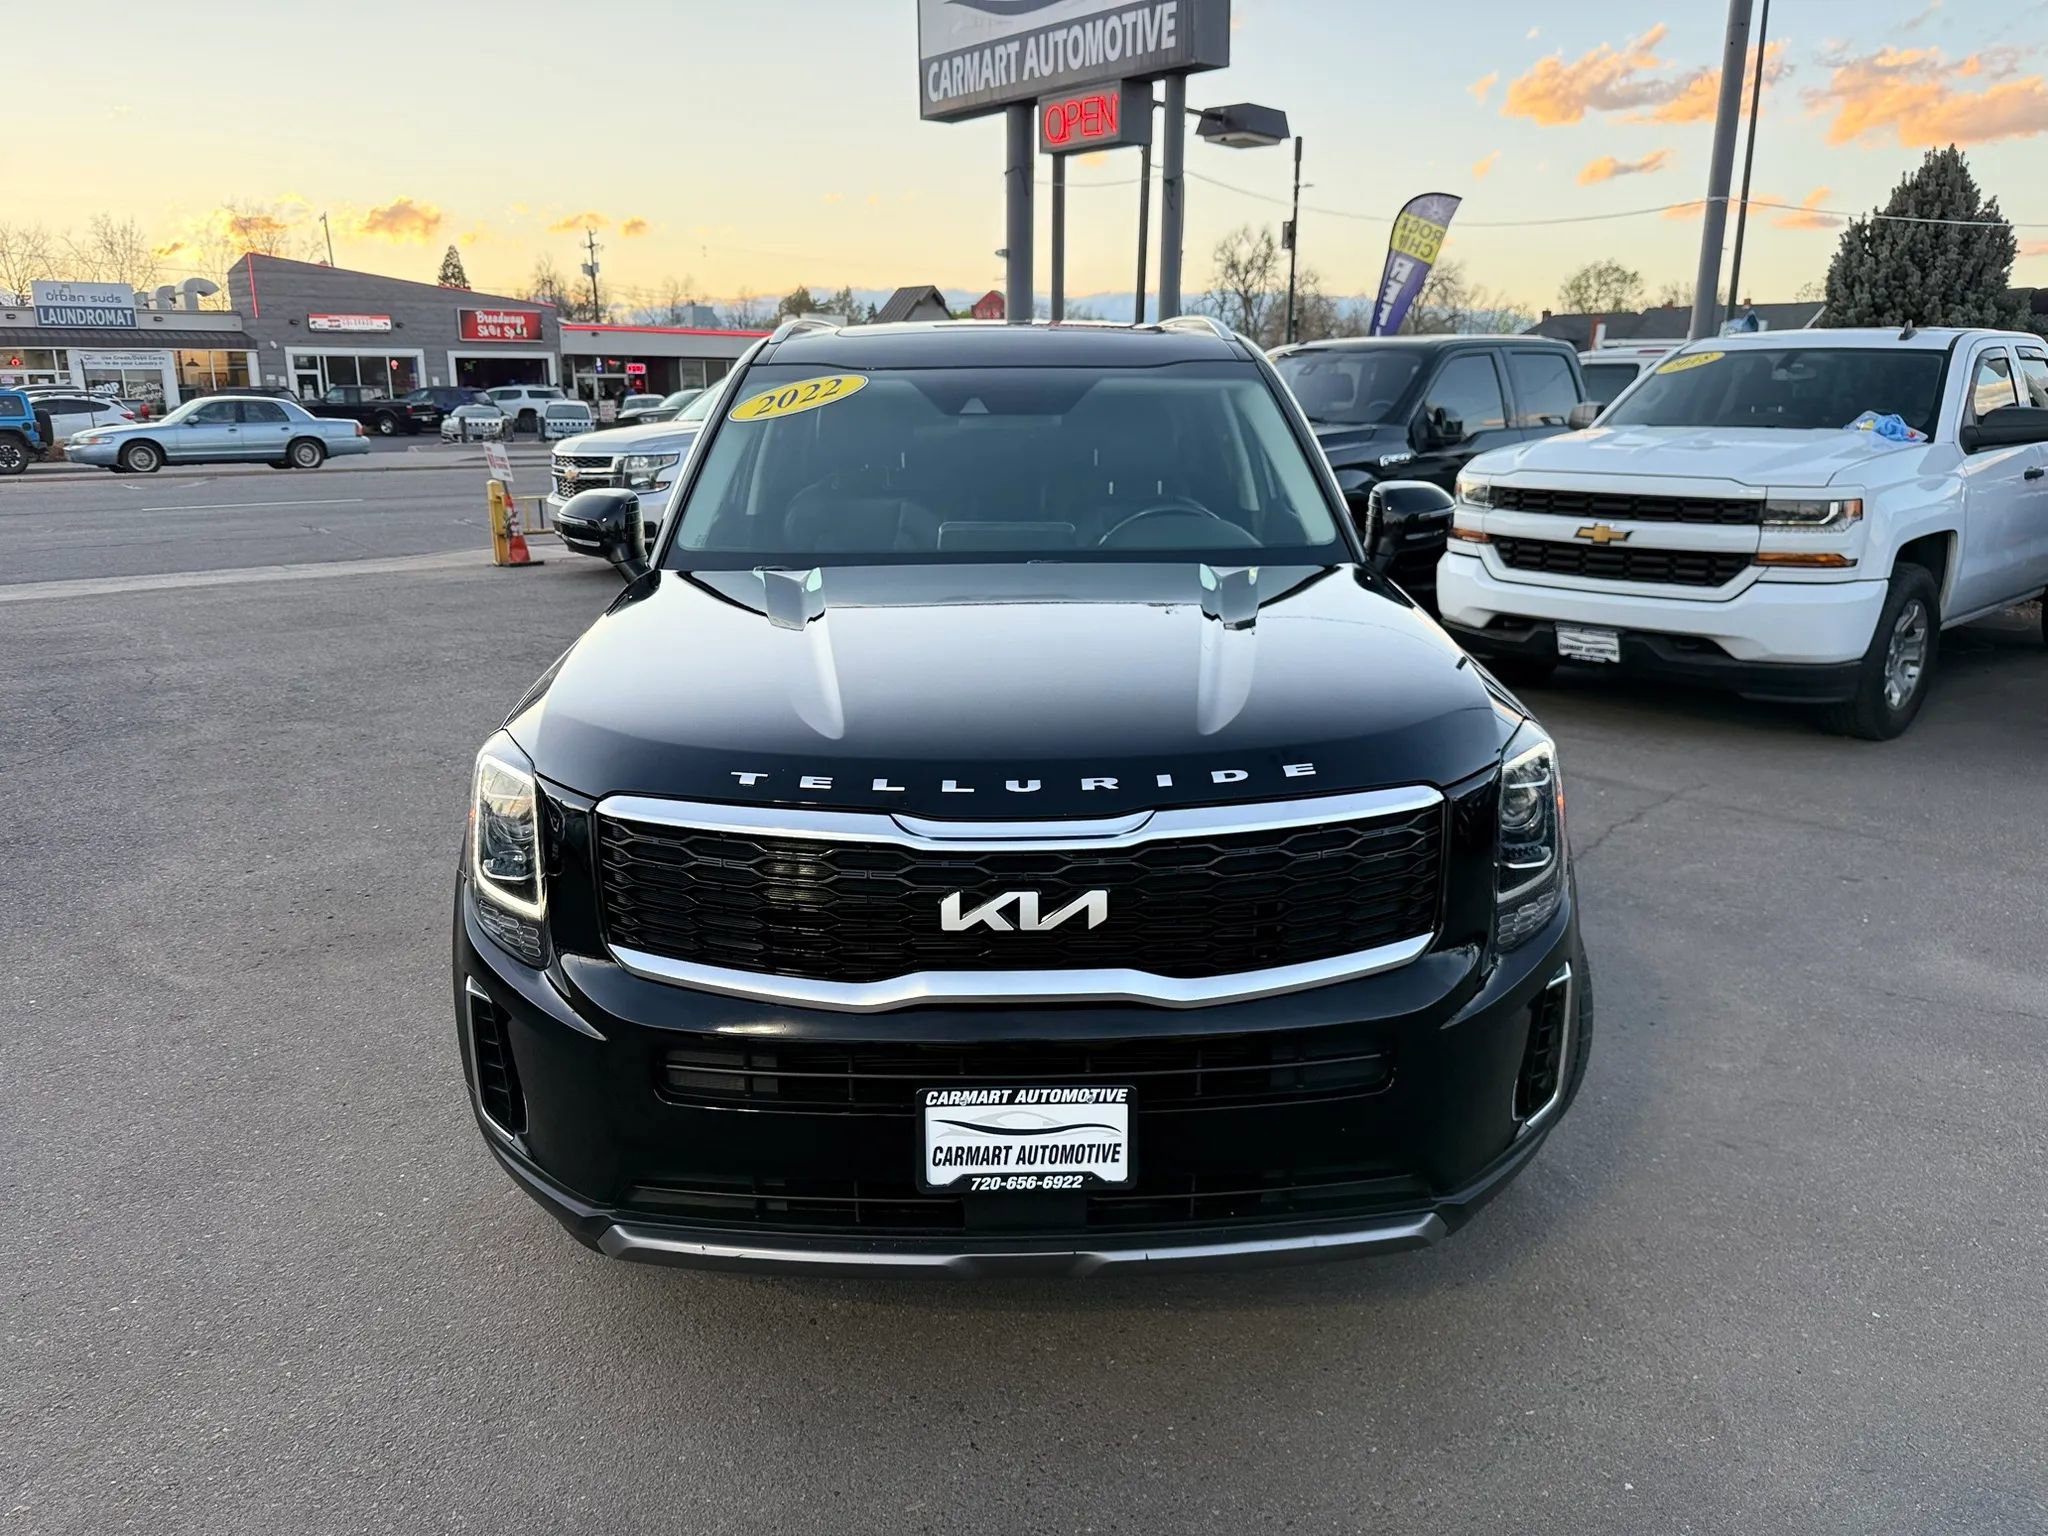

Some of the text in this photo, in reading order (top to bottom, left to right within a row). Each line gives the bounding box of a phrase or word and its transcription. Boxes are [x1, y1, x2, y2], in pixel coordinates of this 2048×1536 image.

[928, 1, 1178, 103] CARMART AUTOMOTIVE
[1044, 93, 1119, 145] OPEN
[90, 292, 122, 304] suds
[40, 307, 132, 326] LAUNDROMAT
[753, 378, 842, 417] 2022
[730, 762, 1316, 792] TELLURIDE
[940, 889, 1108, 931] KIA
[926, 1088, 1129, 1106] CARMART AUTOMOTIVE
[932, 1143, 1122, 1167] CARMART AUTOMOTIVE
[971, 1175, 1084, 1191] 720-656-6922
